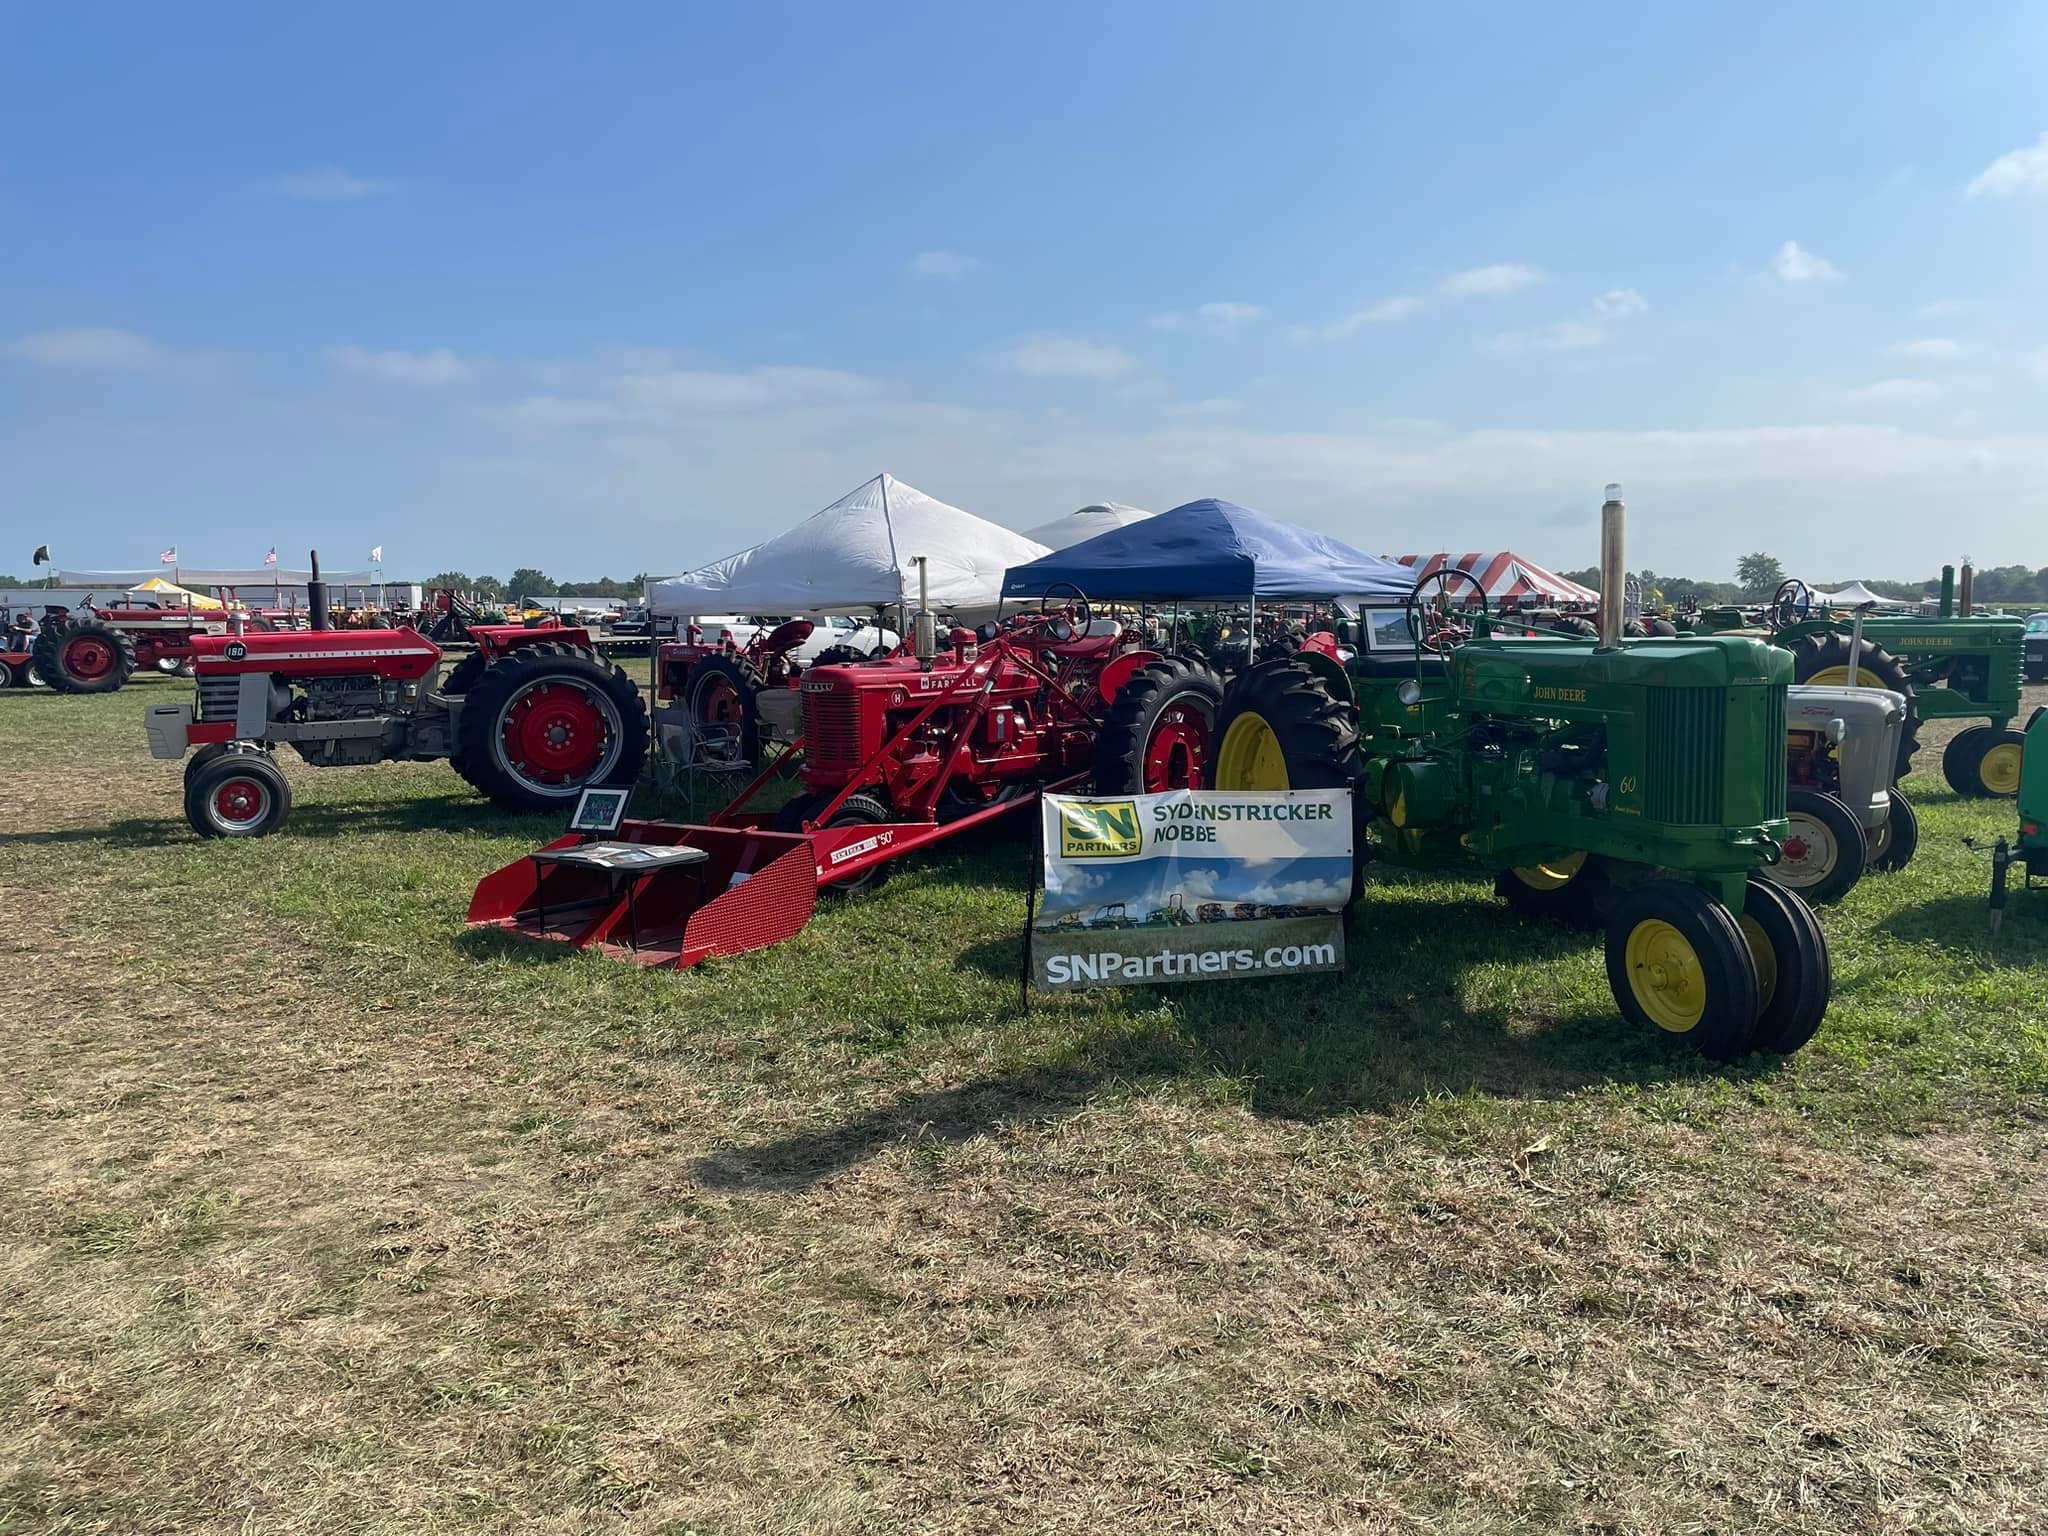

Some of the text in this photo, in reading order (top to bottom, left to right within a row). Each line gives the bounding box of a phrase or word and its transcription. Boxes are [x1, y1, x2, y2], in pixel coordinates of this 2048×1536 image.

[1901, 637, 1952, 646] JOHN DEERE
[227, 647, 244, 657] 180
[931, 678, 977, 689] FARLL
[894, 693, 901, 704] H
[1533, 686, 1587, 702] JOHN DEERE
[1620, 776, 1636, 794] 60
[1153, 803, 1333, 822] SYDENSTRICKER
[1153, 825, 1217, 844] NOBBE
[1067, 841, 1137, 852] PARTNERS
[1046, 943, 1335, 984] SNPartners.com
